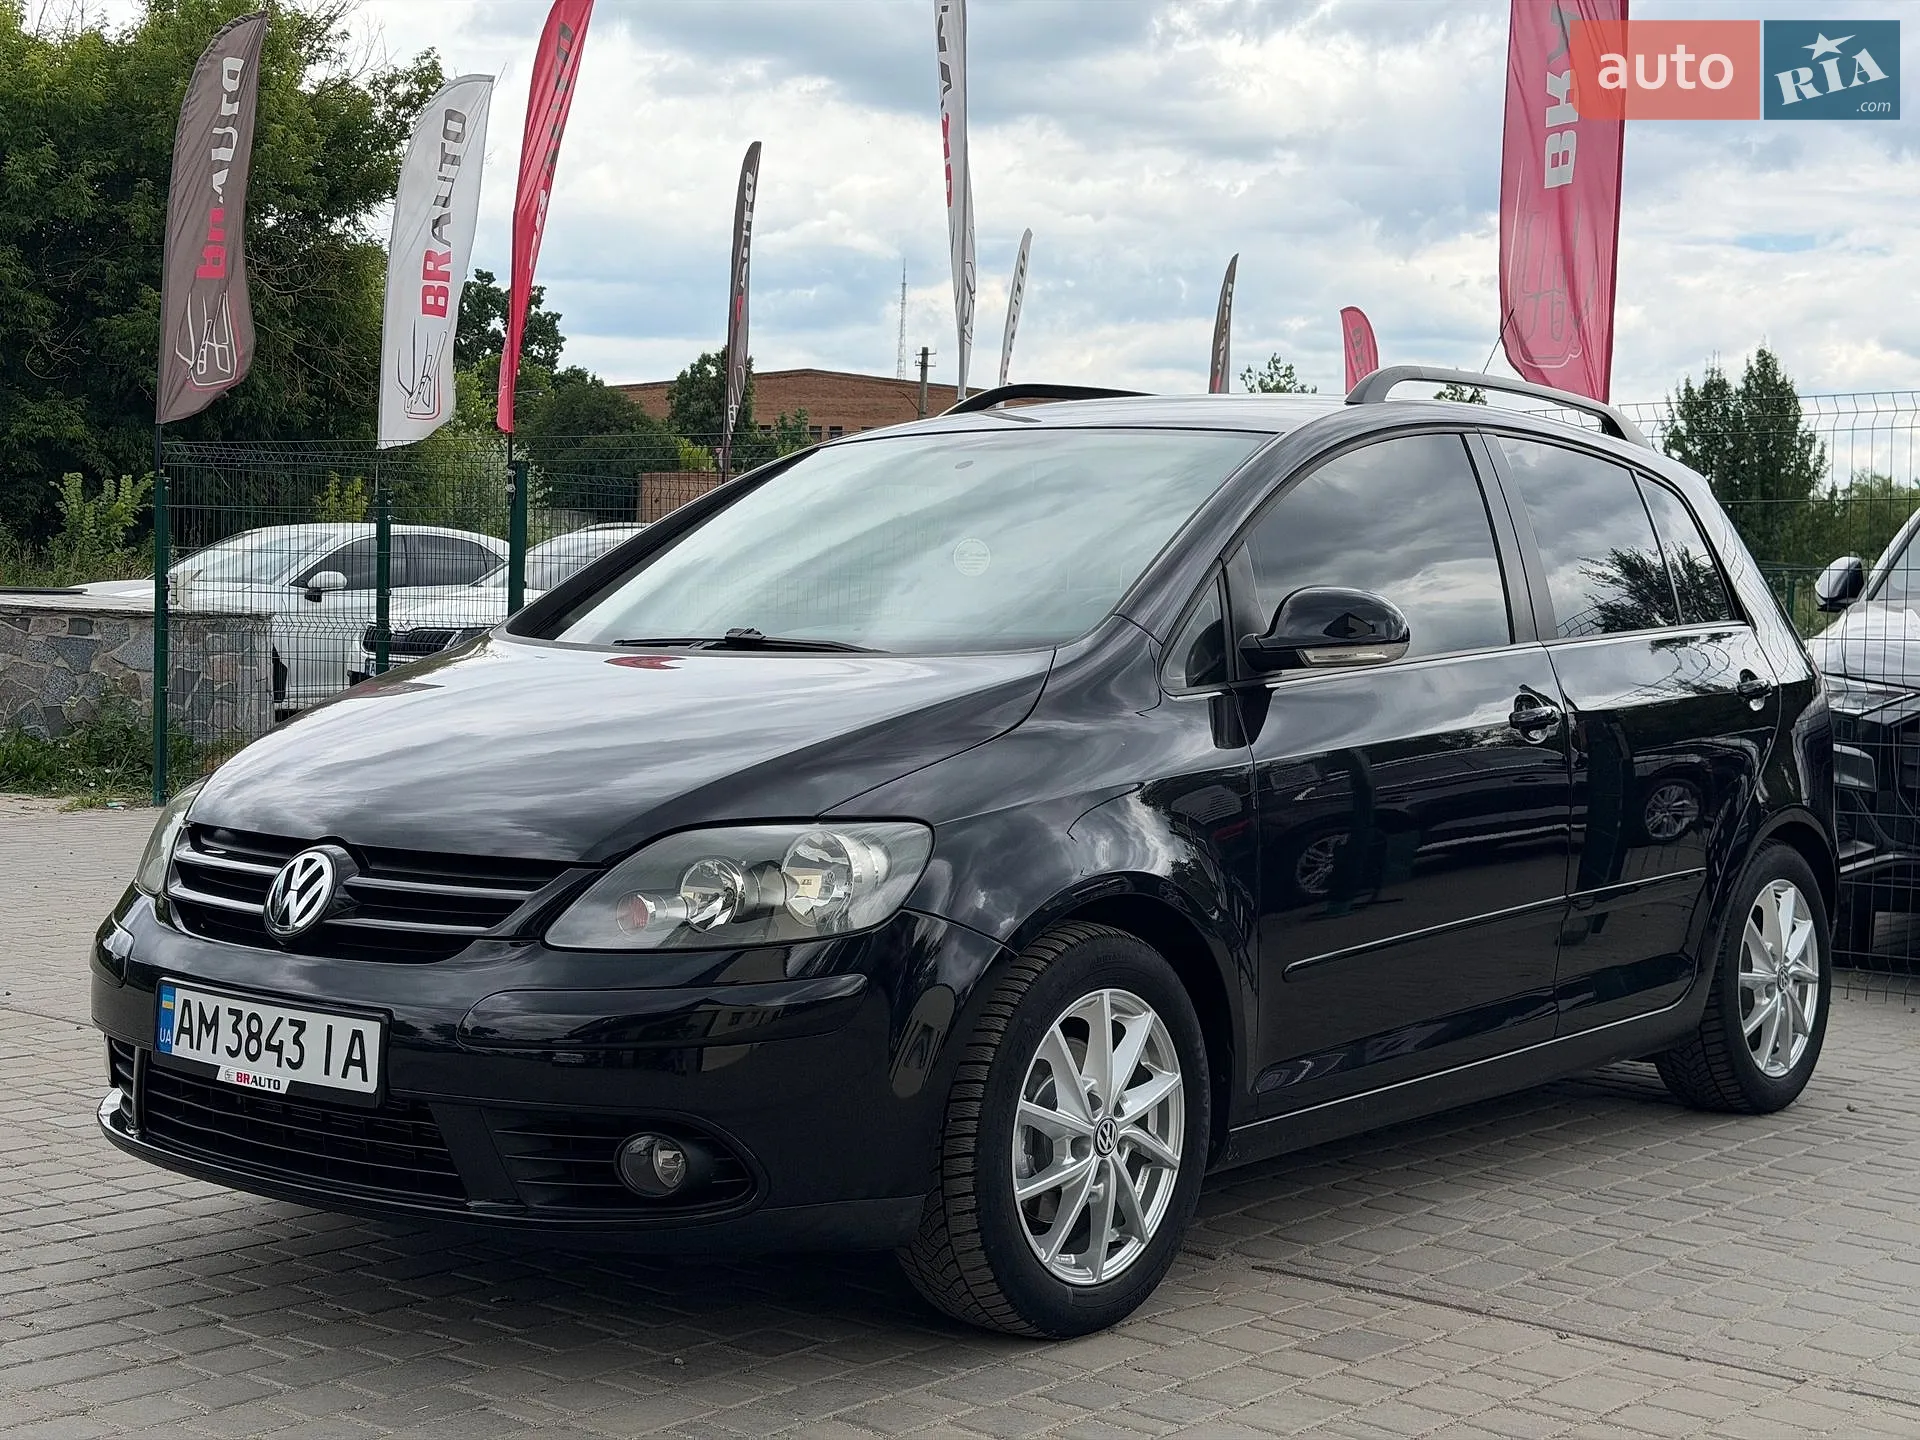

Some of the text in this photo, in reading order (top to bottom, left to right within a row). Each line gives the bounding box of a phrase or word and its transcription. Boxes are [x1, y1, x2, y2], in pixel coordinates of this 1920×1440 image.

[422, 109, 466, 319] BRAUTO
[159, 1028, 172, 1045] UA
[236, 1071, 281, 1091] BRAUTO
